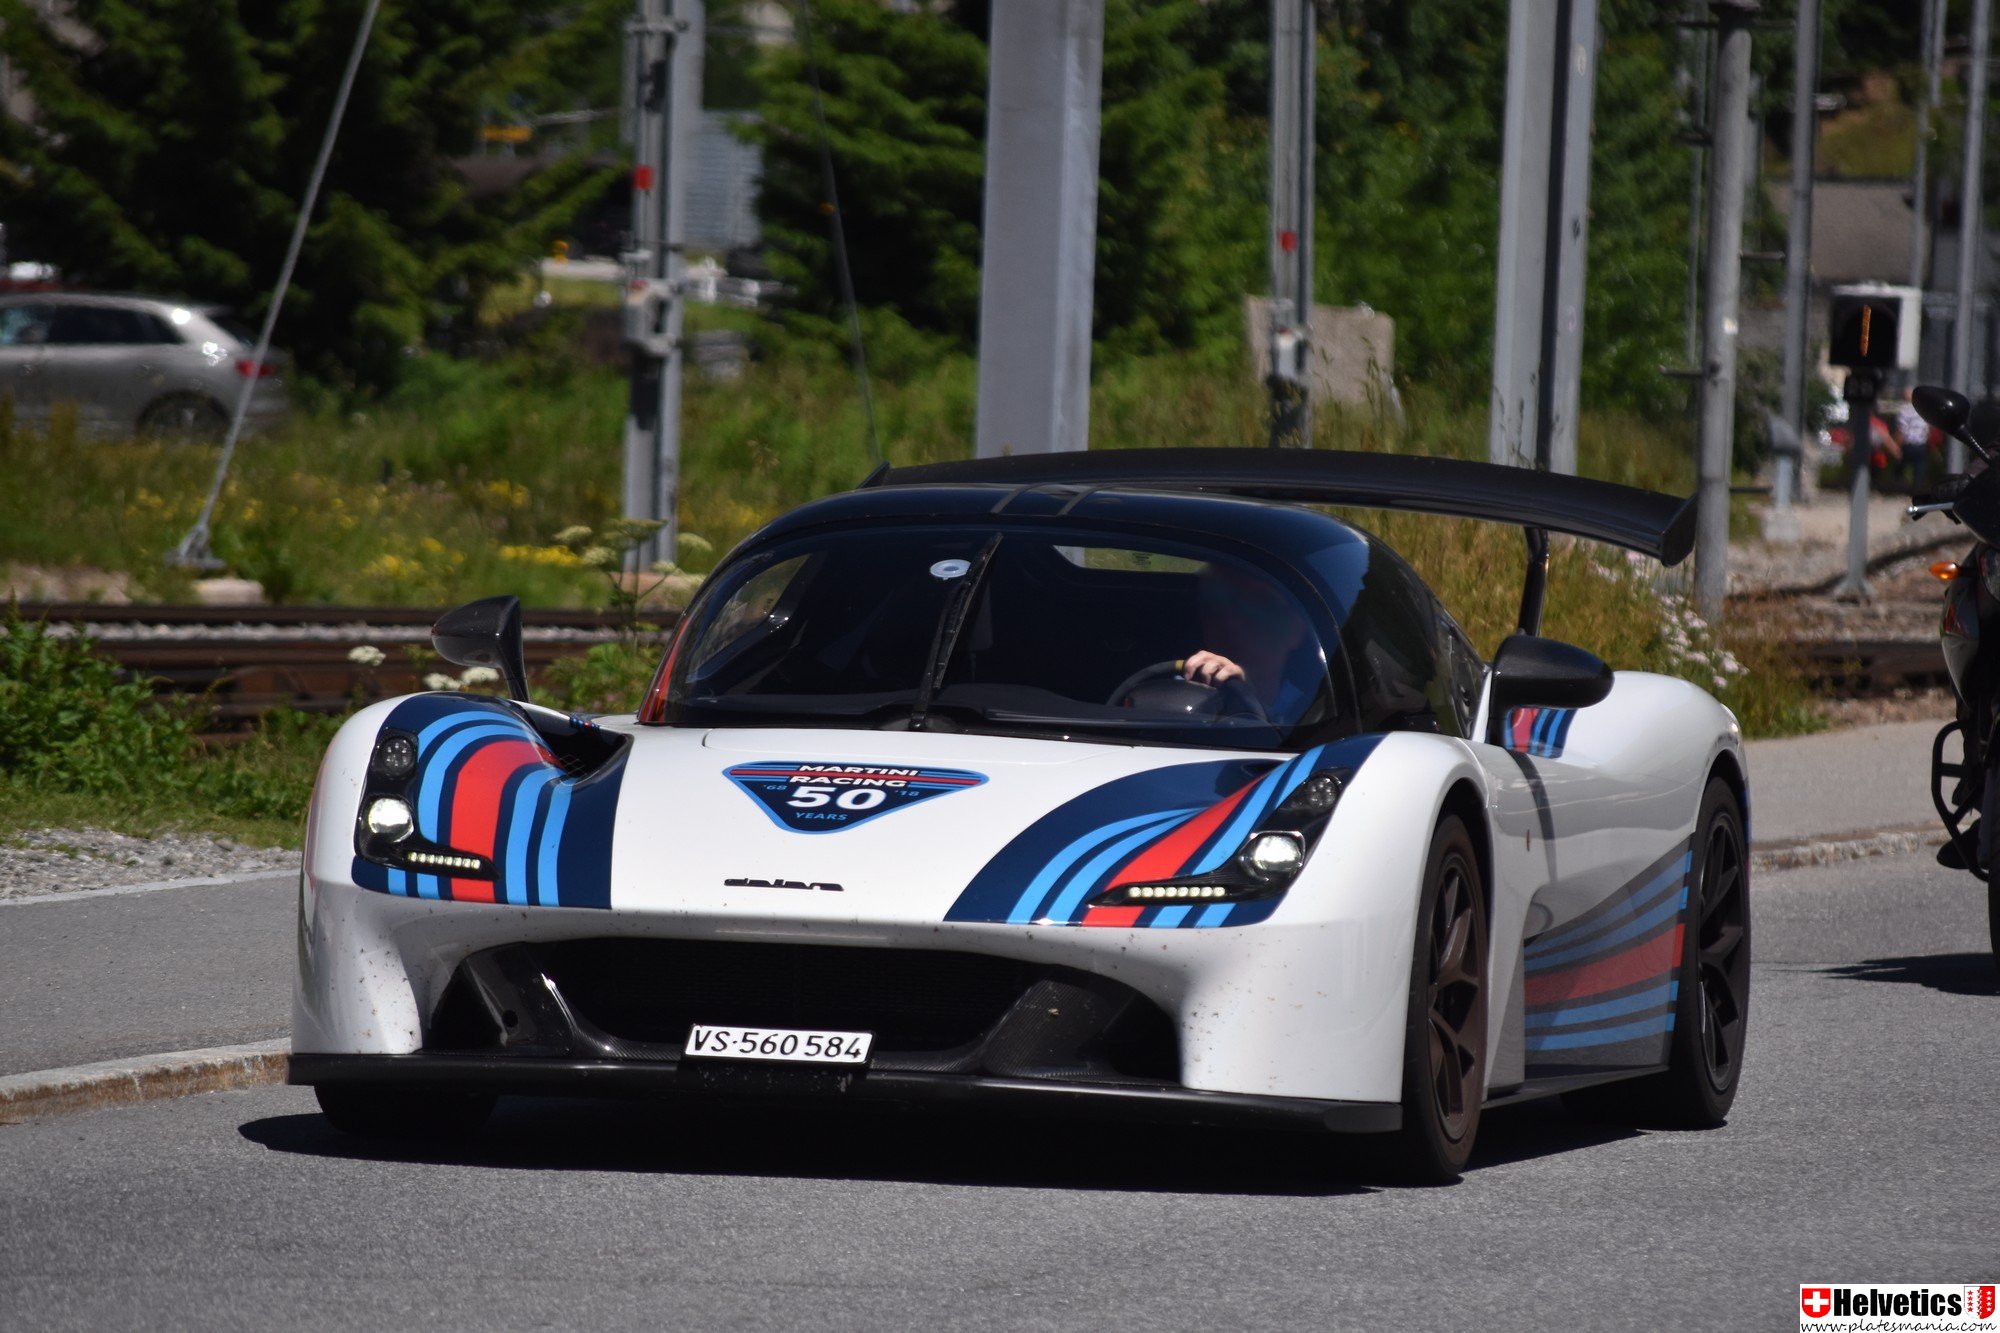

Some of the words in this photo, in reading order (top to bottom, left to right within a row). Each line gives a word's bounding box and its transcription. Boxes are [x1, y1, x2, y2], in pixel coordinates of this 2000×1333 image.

[799, 765, 919, 776] MARTINI
[789, 775, 908, 788] RACING
[785, 785, 887, 810] 50
[795, 812, 849, 821] YEARS
